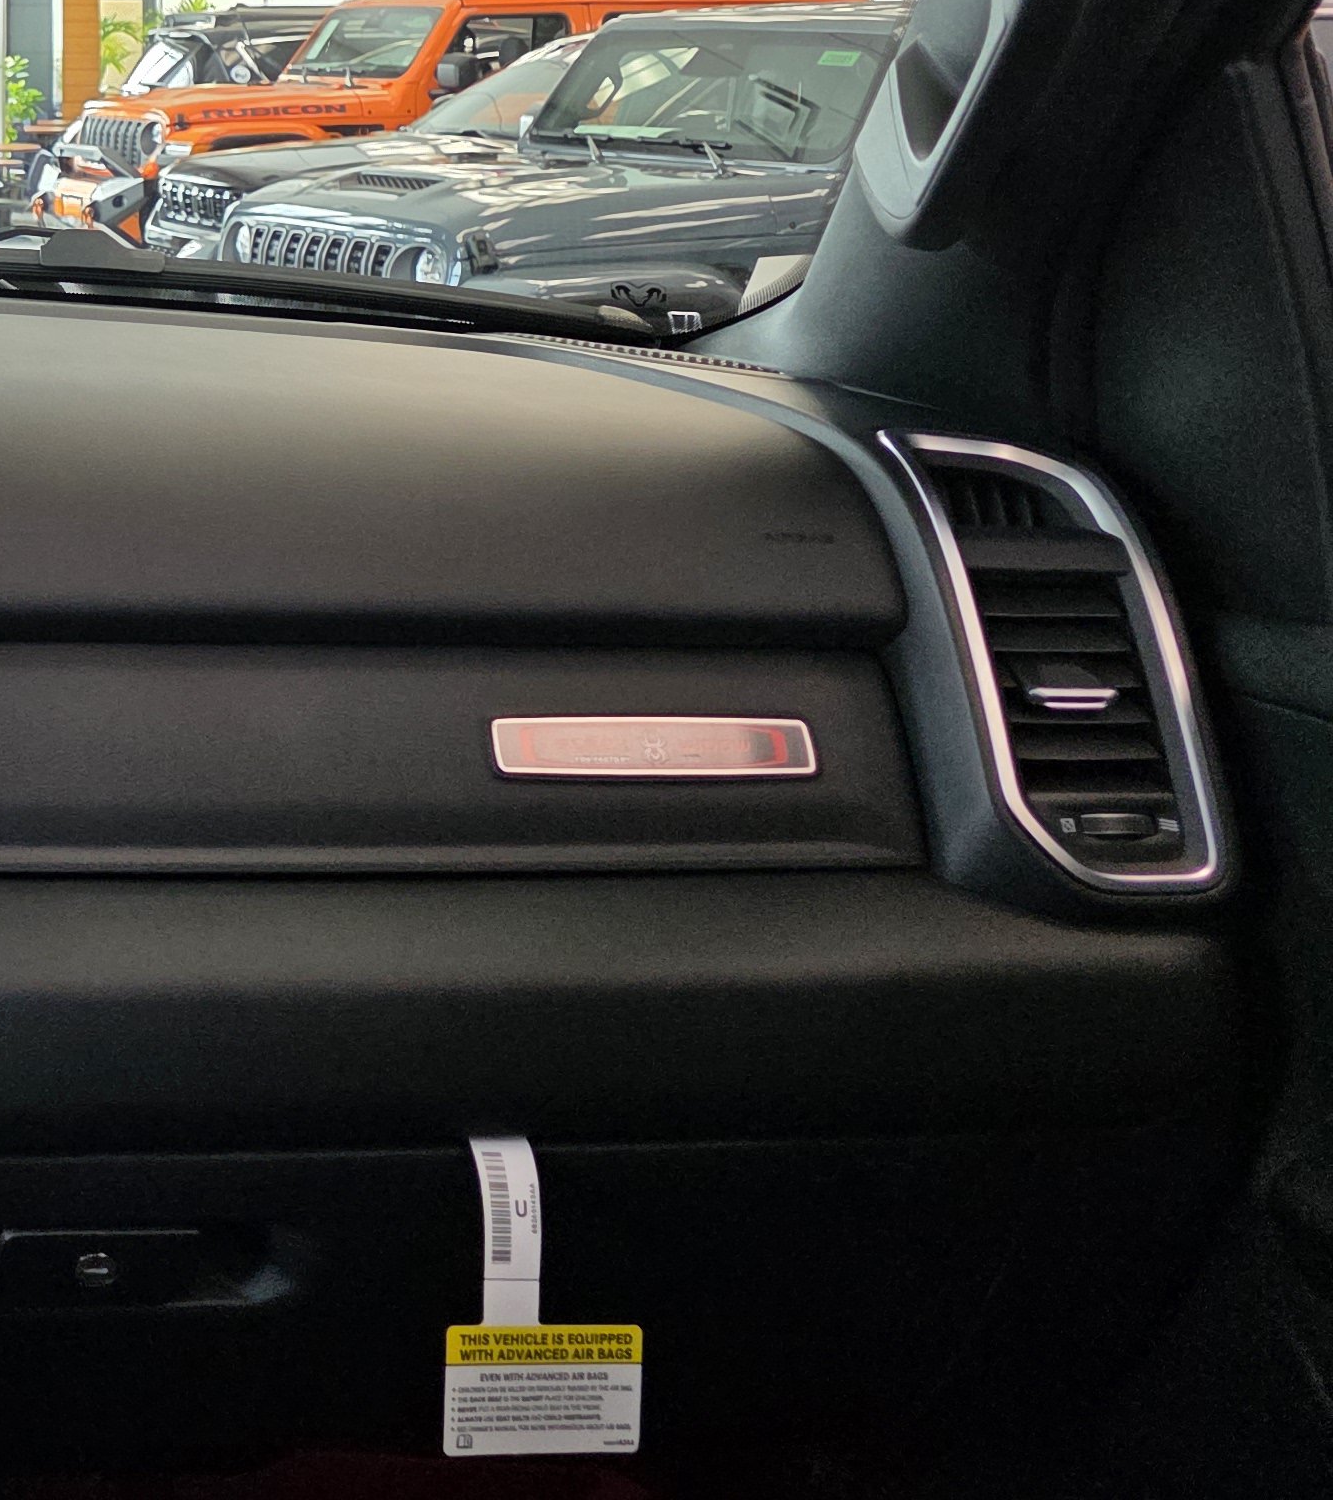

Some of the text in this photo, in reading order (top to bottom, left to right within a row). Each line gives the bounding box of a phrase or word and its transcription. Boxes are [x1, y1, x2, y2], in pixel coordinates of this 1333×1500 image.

[201, 104, 347, 119] RUBICON
[460, 1333, 633, 1346] THIS VEHICLE IS EQUIPPED
[460, 1348, 633, 1361] WITH ADVANCED AIR BAGS
[480, 1372, 608, 1382] EVEN WITH ADVANCED AIR BAGS
